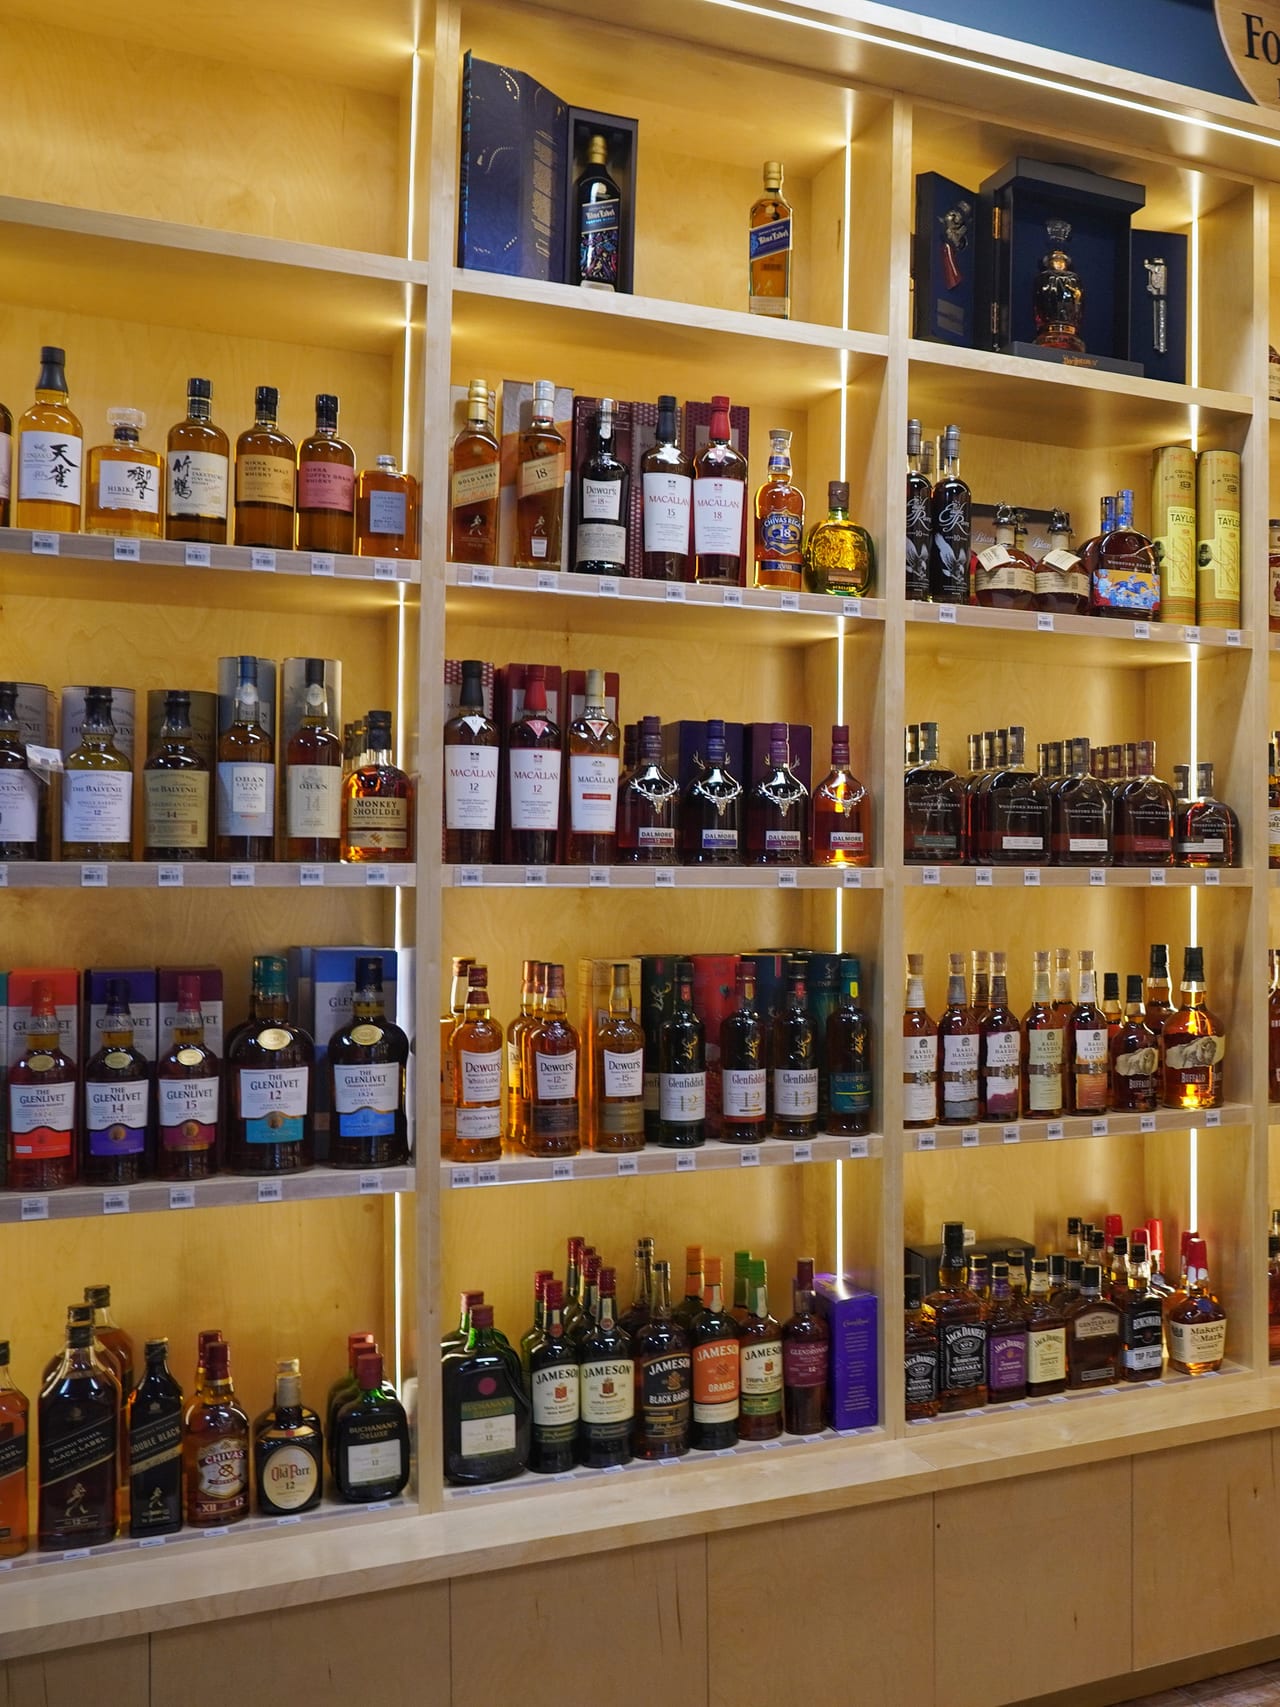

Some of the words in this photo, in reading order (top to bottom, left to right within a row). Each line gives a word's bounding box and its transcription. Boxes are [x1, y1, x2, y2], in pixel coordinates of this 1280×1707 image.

[535, 468, 549, 480] 18
[107, 485, 134, 494] HIBIKI
[666, 508, 676, 517] 15
[713, 511, 723, 520] 18
[763, 515, 788, 526] CHIVAS
[779, 527, 792, 538] 18
[234, 775, 265, 784] OBAN
[450, 769, 497, 779] MACALLAN
[513, 770, 560, 781] MACALLAN
[577, 775, 617, 785] MACALLAN
[298, 782, 329, 791] OBAN
[469, 782, 480, 792] 12
[532, 784, 543, 794] 12
[303, 796, 321, 813] 14
[356, 799, 398, 809] MONKEY
[353, 806, 401, 817] SHOULDER
[640, 830, 674, 840] DALMORE
[704, 832, 737, 840] DALMORE
[768, 833, 799, 842] DALMORE
[832, 834, 863, 843] DALMORE
[267, 1073, 283, 1081] THE
[358, 1069, 372, 1077] THE
[250, 1078, 300, 1091] GLENLIVET
[344, 1074, 388, 1085] GLENLIVET
[35, 1088, 50, 1096] THE
[110, 1086, 126, 1095] THE
[183, 1083, 199, 1091] THE
[19, 1093, 65, 1105] GLENLIVET
[92, 1091, 142, 1104] GLENLIVET
[166, 1088, 214, 1101] GLENLIVET
[269, 1090, 282, 1101] 12
[111, 1103, 125, 1114] 14
[185, 1099, 198, 1110] 15
[945, 1329, 963, 1345] JACK
[962, 1326, 987, 1340] DANIEL'S
[1190, 1324, 1225, 1337] Maker's
[1200, 1333, 1224, 1344] Mark
[583, 1364, 632, 1379] JAMESON
[950, 1363, 983, 1373] WHISKEY
[708, 1381, 736, 1393] ORANGE
[649, 1394, 671, 1405] BLACK
[158, 1426, 181, 1443] BLACK
[77, 1435, 109, 1452] LABEL
[204, 1451, 245, 1464] CHIVAS
[271, 1466, 288, 1482] Old
[288, 1466, 311, 1480] Parr
[284, 1481, 296, 1490] 12
[234, 1497, 245, 1507] 12
